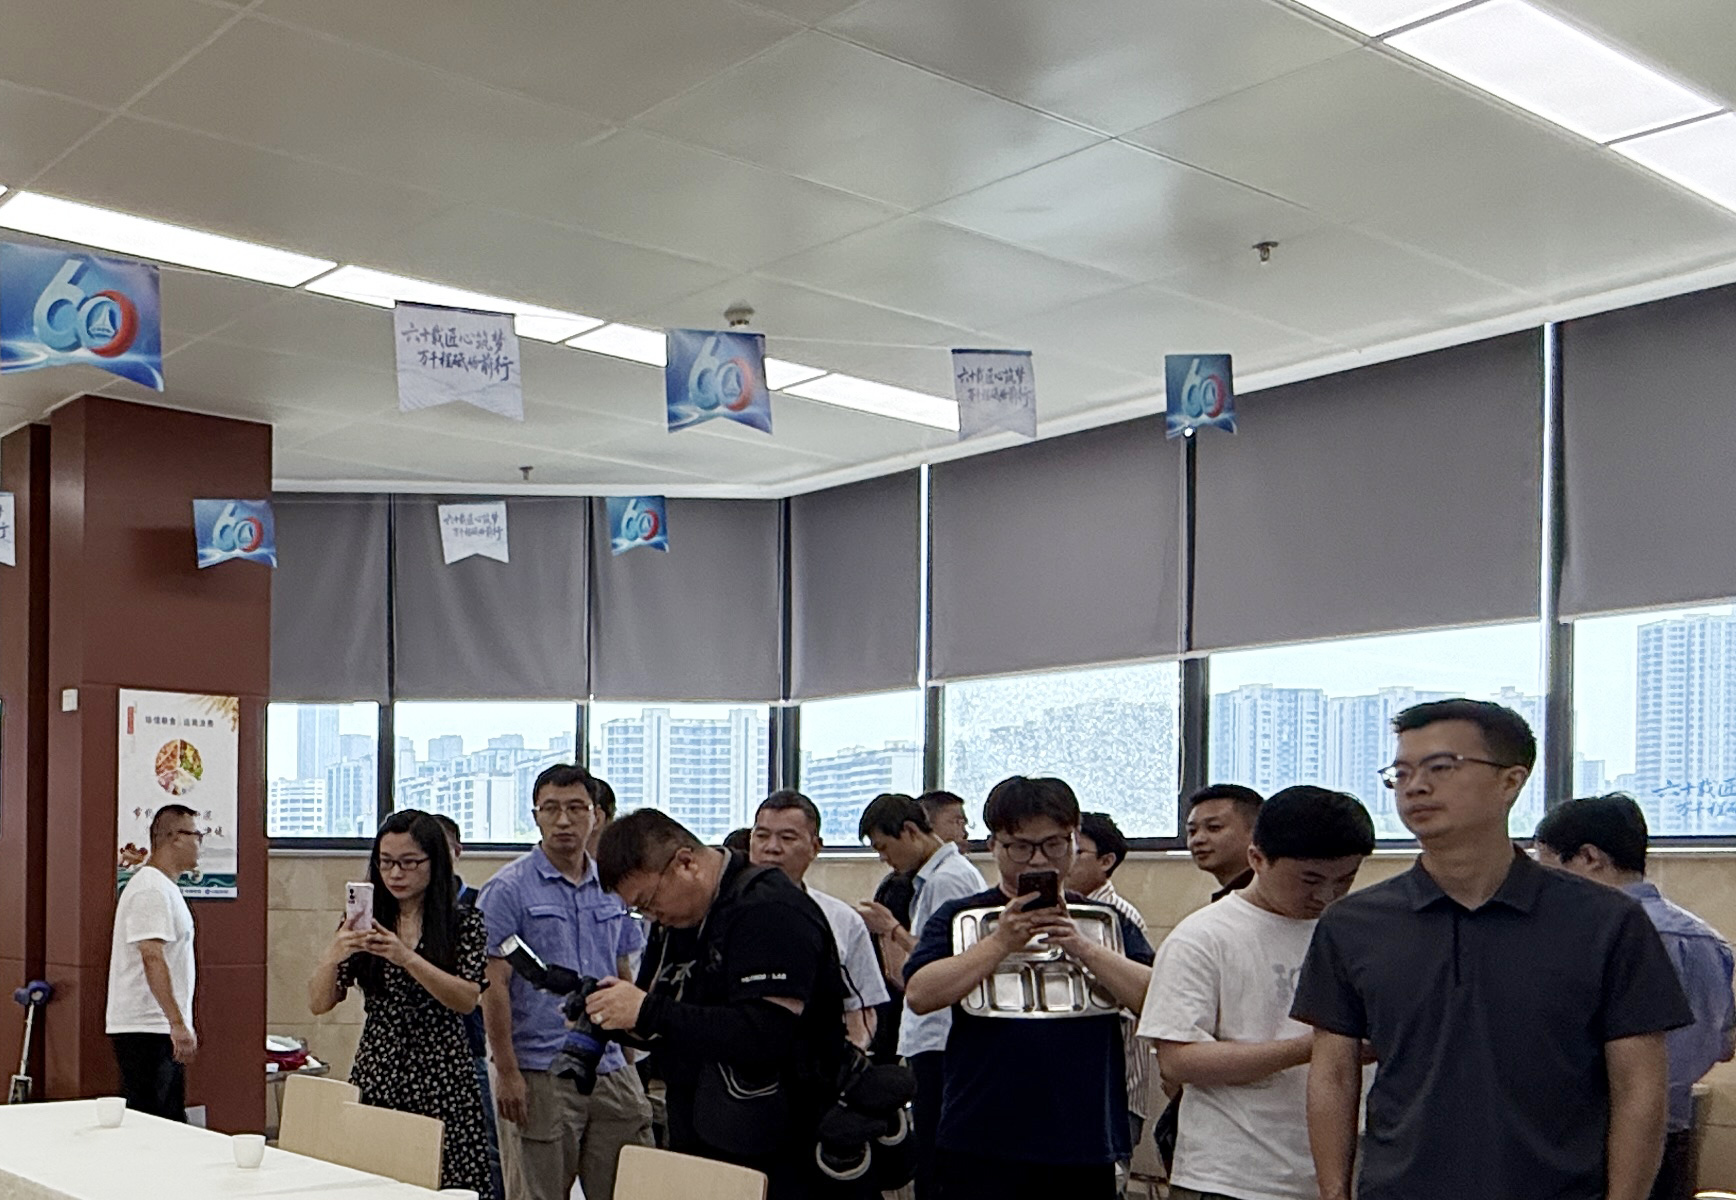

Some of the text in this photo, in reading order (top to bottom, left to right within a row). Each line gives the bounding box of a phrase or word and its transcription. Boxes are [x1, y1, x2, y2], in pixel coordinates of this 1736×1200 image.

[33, 259, 140, 358] 60
[688, 336, 754, 412] 60
[1181, 358, 1227, 418] 60
[212, 503, 265, 553] 60
